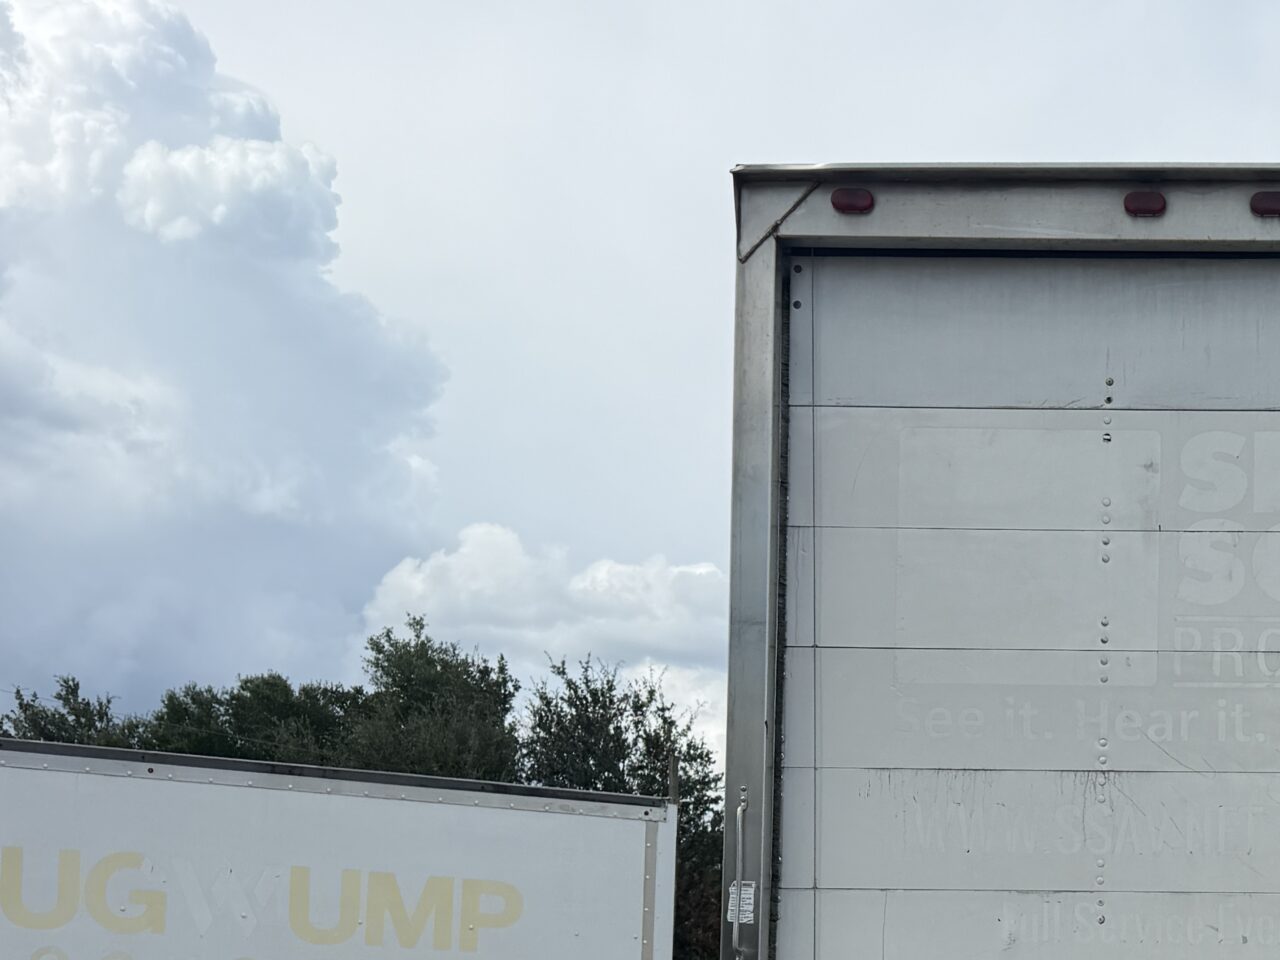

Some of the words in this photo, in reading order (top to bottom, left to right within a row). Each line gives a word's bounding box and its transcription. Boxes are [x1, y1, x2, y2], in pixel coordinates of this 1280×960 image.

[897, 699, 985, 741] See
[1005, 697, 1055, 742] it.
[1076, 700, 1199, 743] Hear
[1216, 699, 1267, 743] it.
